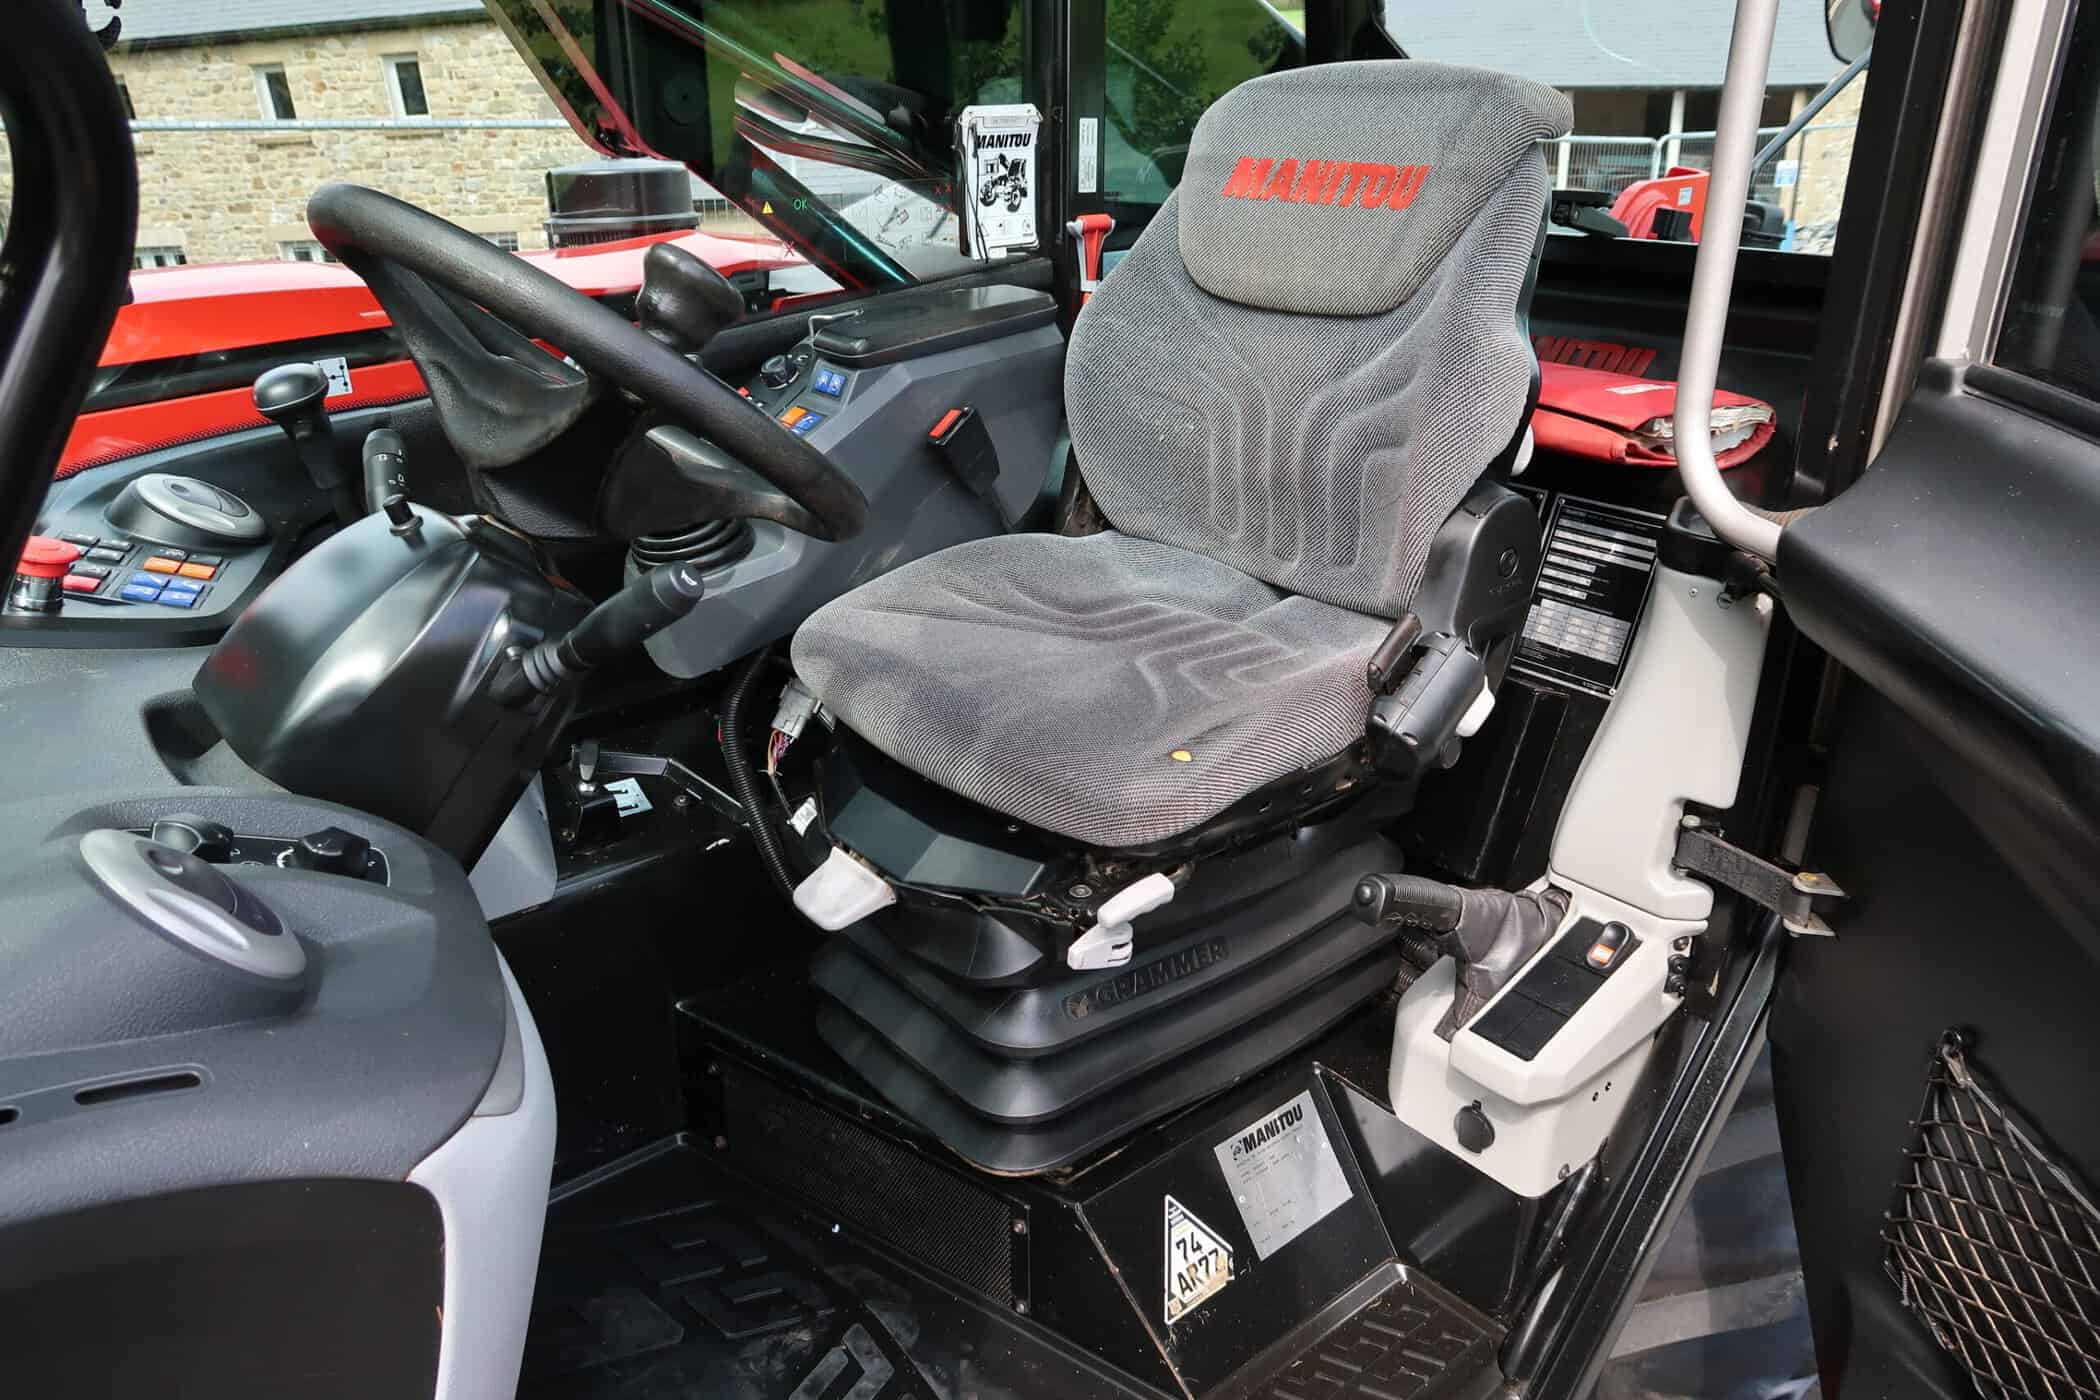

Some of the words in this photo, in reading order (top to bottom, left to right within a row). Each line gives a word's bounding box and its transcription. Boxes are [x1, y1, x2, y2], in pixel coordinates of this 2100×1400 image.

[975, 132, 1032, 149] MANITOU
[793, 199, 809, 210] OK
[1221, 155, 1434, 212] MANITOU
[1530, 335, 1657, 377] NITOU
[1094, 941, 1229, 1004] GRAMMER
[1241, 1103, 1304, 1154] MANITOU
[1175, 1231, 1202, 1262] 74
